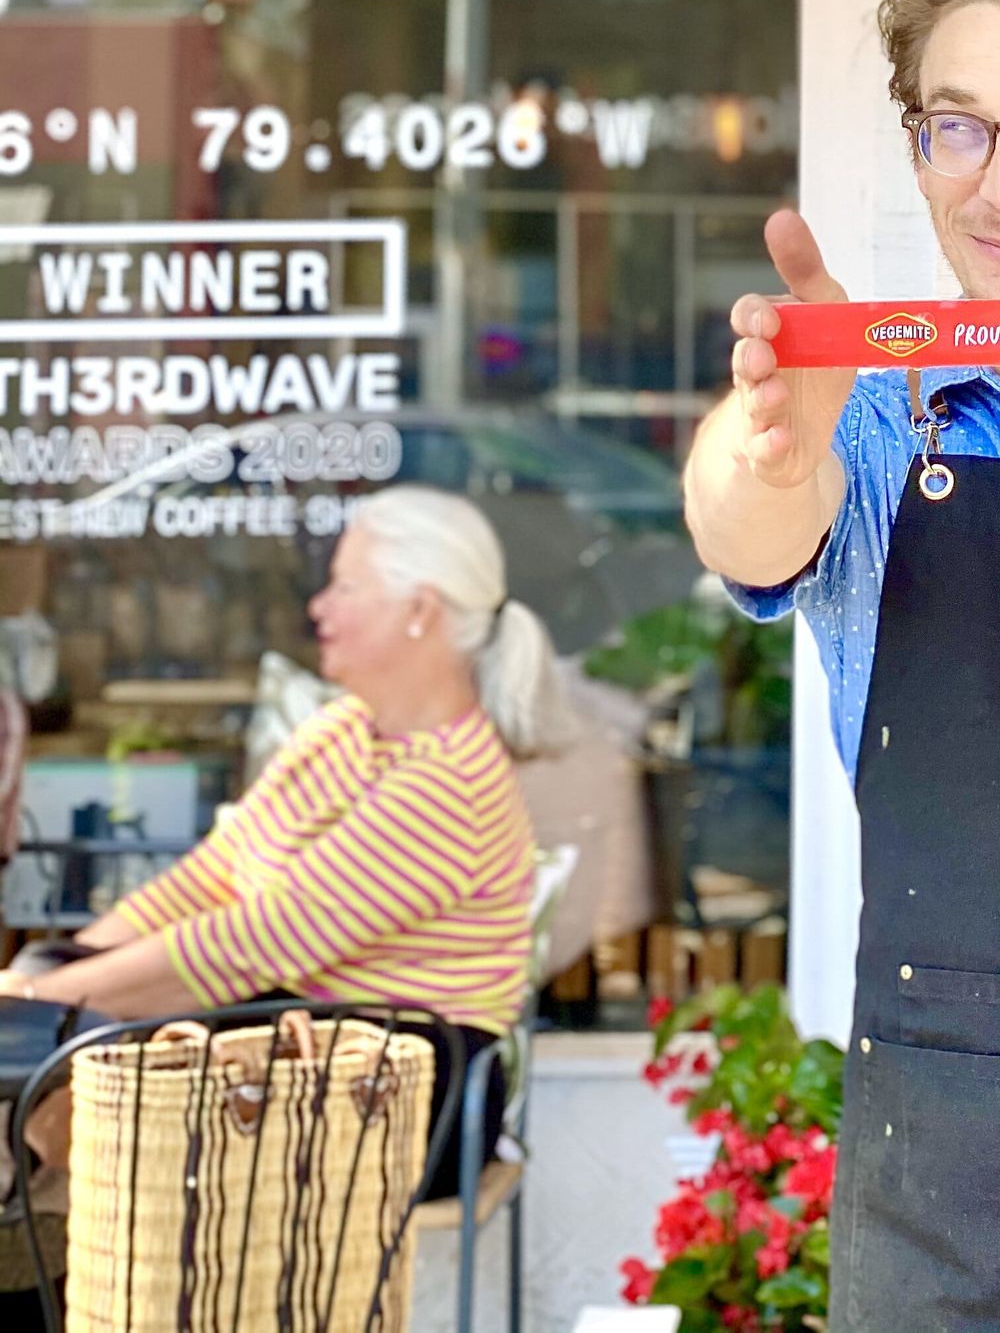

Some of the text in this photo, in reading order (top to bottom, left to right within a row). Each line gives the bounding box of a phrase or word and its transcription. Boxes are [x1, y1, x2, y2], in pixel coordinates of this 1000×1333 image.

[40, 250, 331, 313] WINNER
[871, 325, 931, 341] VEGEMITE
[238, 420, 403, 482] 2020
[153, 495, 299, 538] COFFEE
